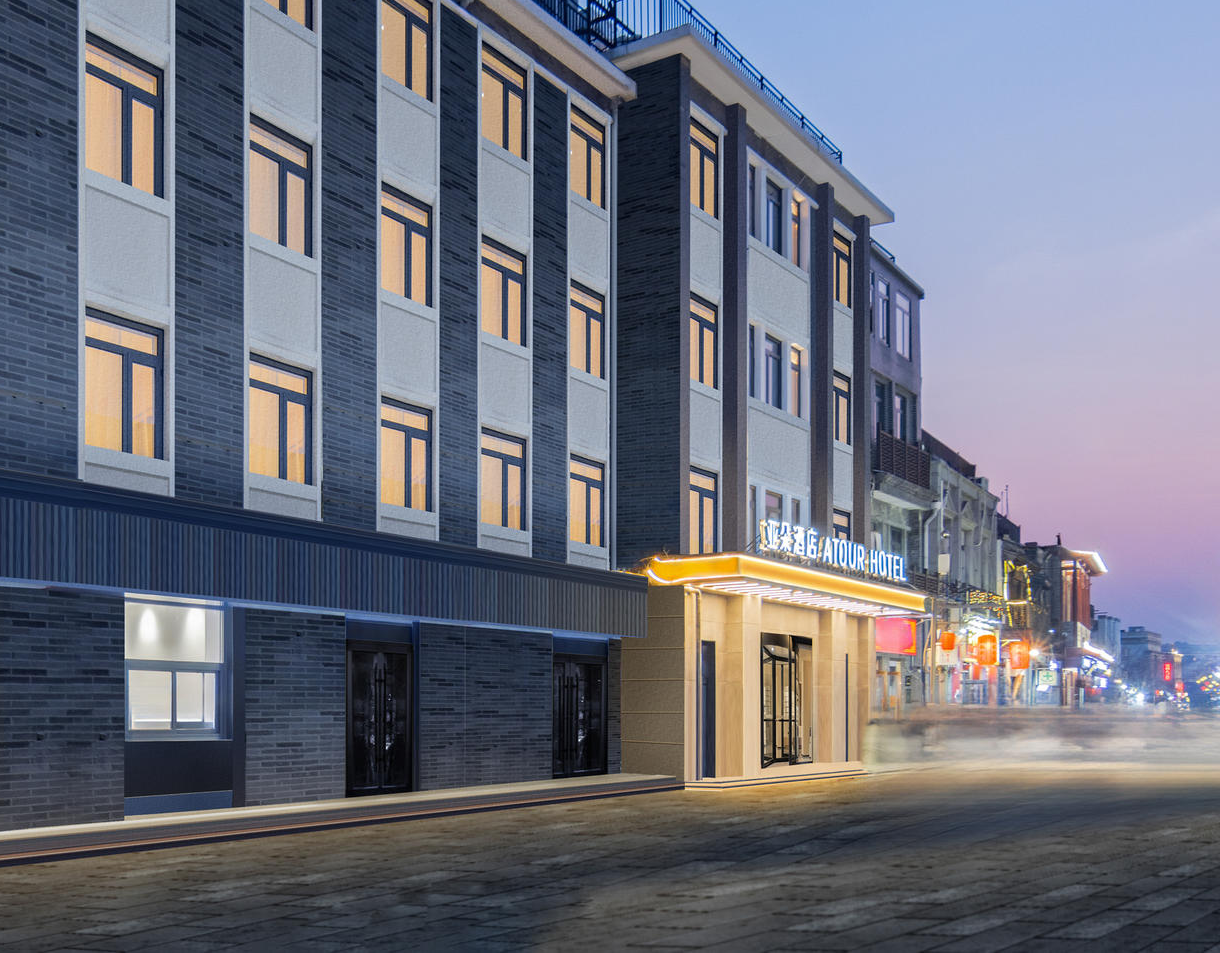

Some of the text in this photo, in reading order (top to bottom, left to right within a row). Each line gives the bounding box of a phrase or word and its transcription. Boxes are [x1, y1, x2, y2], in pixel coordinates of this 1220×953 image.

[766, 519, 907, 582] 亚朵酒店 ATOUR HOTEL
